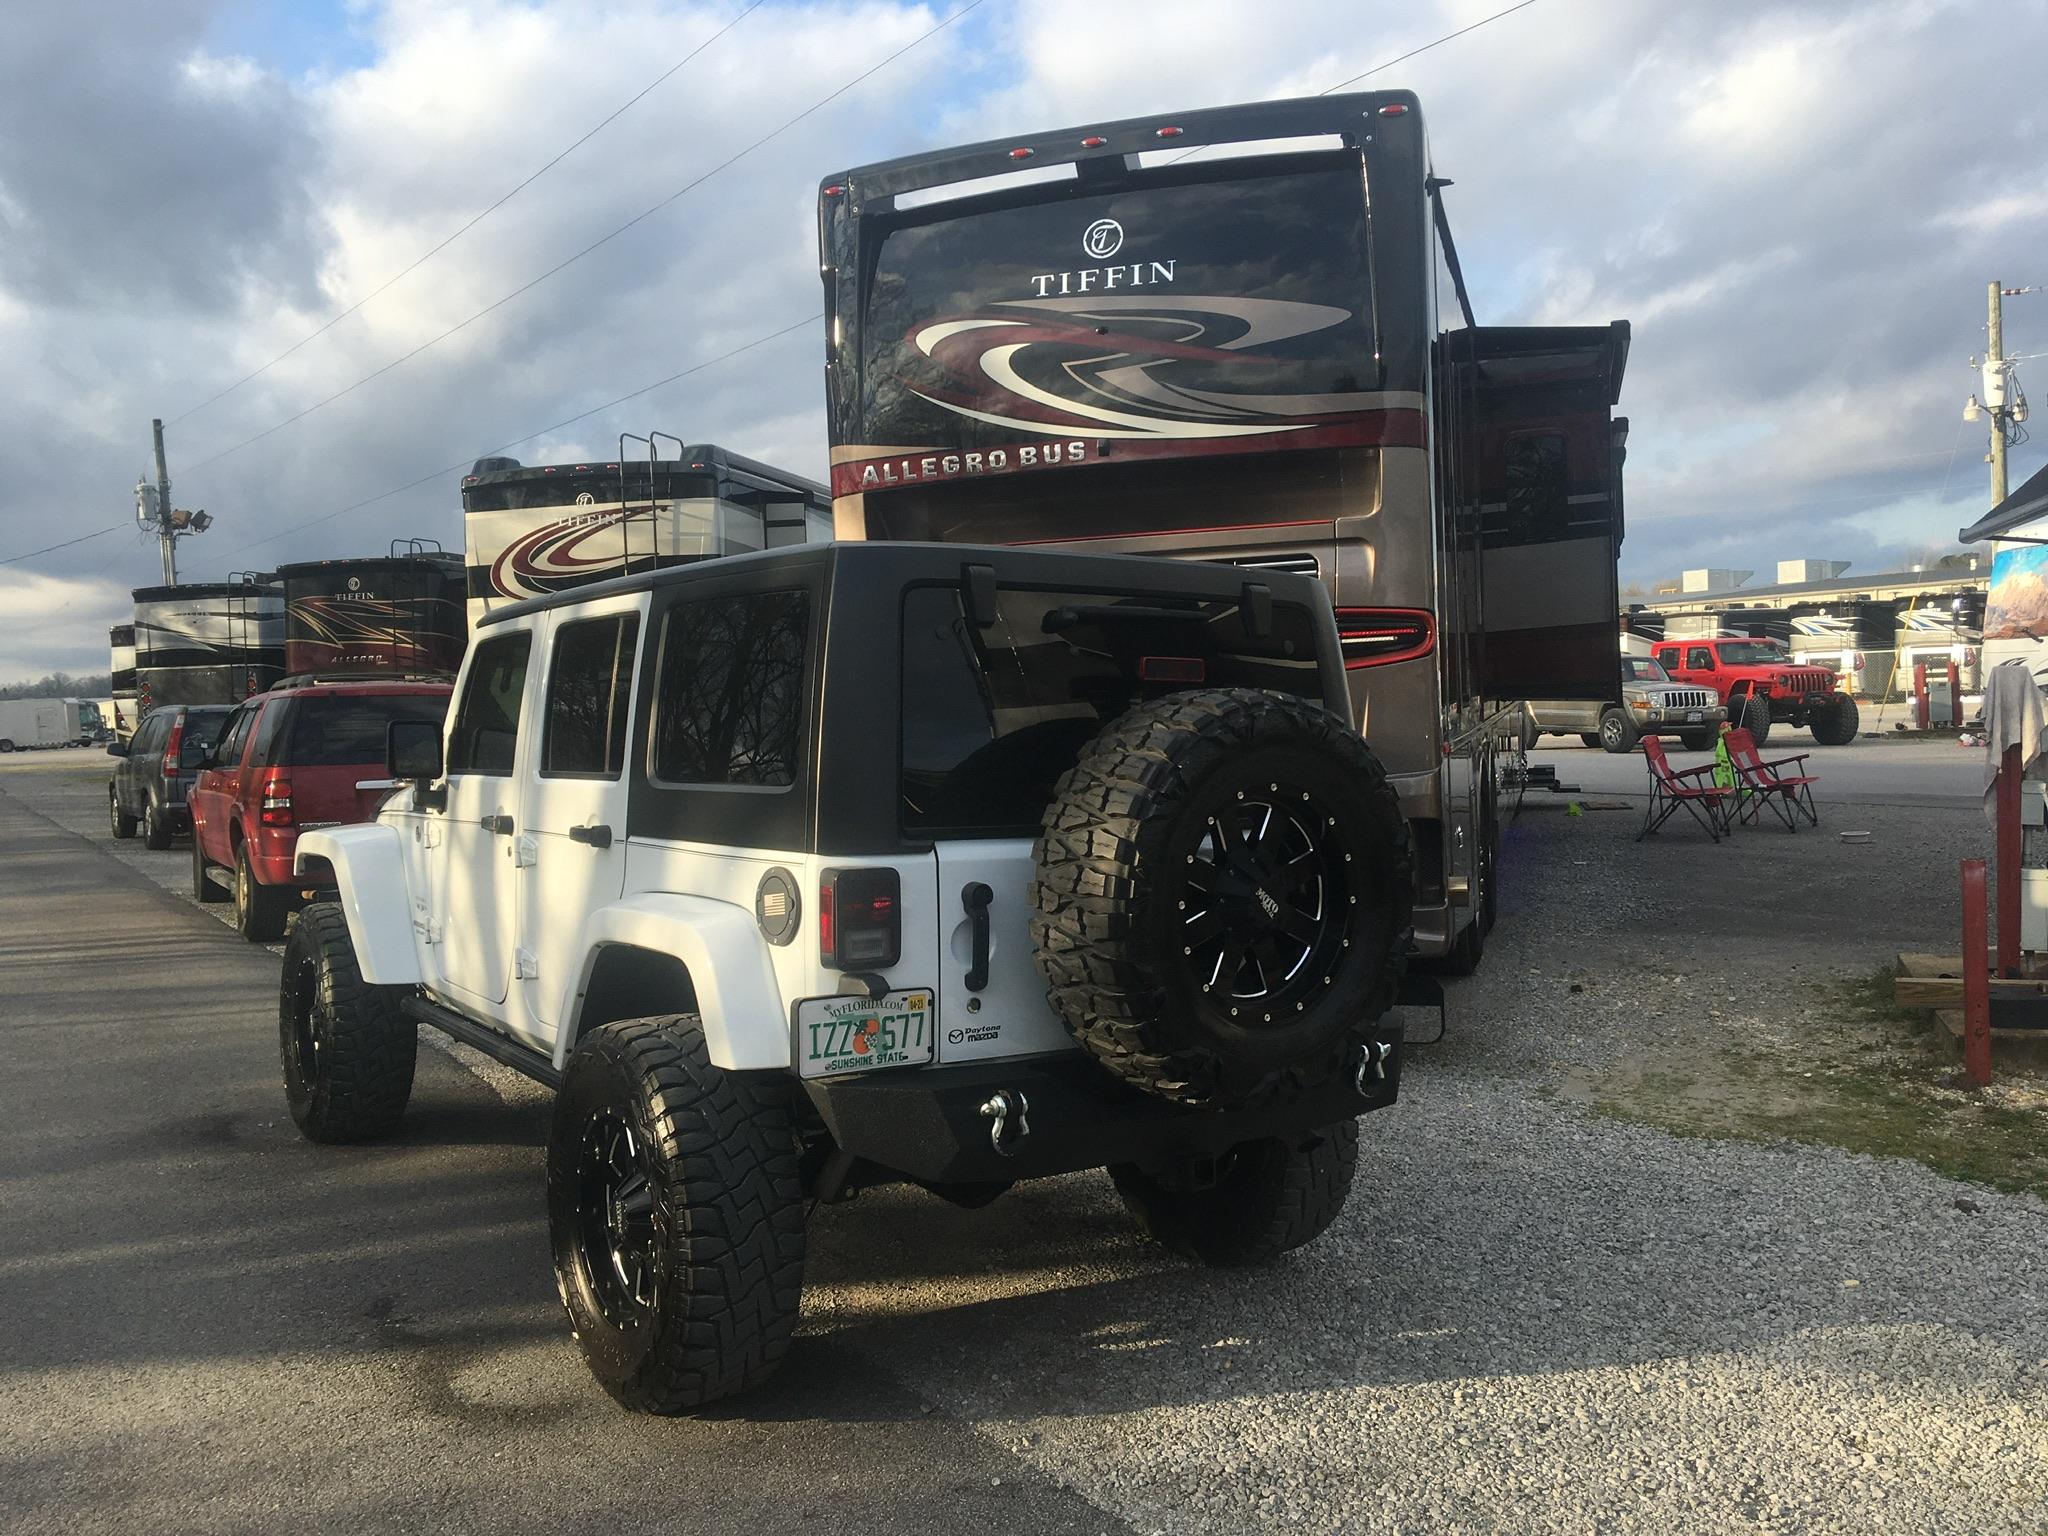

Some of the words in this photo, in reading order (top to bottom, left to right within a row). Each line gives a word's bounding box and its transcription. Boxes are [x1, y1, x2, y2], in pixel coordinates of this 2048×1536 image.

[1031, 260, 1177, 297] TIFFIN
[862, 450, 1007, 486] ALLEGRO
[1020, 441, 1085, 467] BUS
[335, 591, 375, 601] TIFFIN
[809, 1020, 853, 1060] IZZ
[882, 1012, 925, 1051] S77
[965, 1025, 1001, 1034] Daytona
[831, 1055, 873, 1071] SUNSHINE
[877, 1052, 904, 1064] STATE
